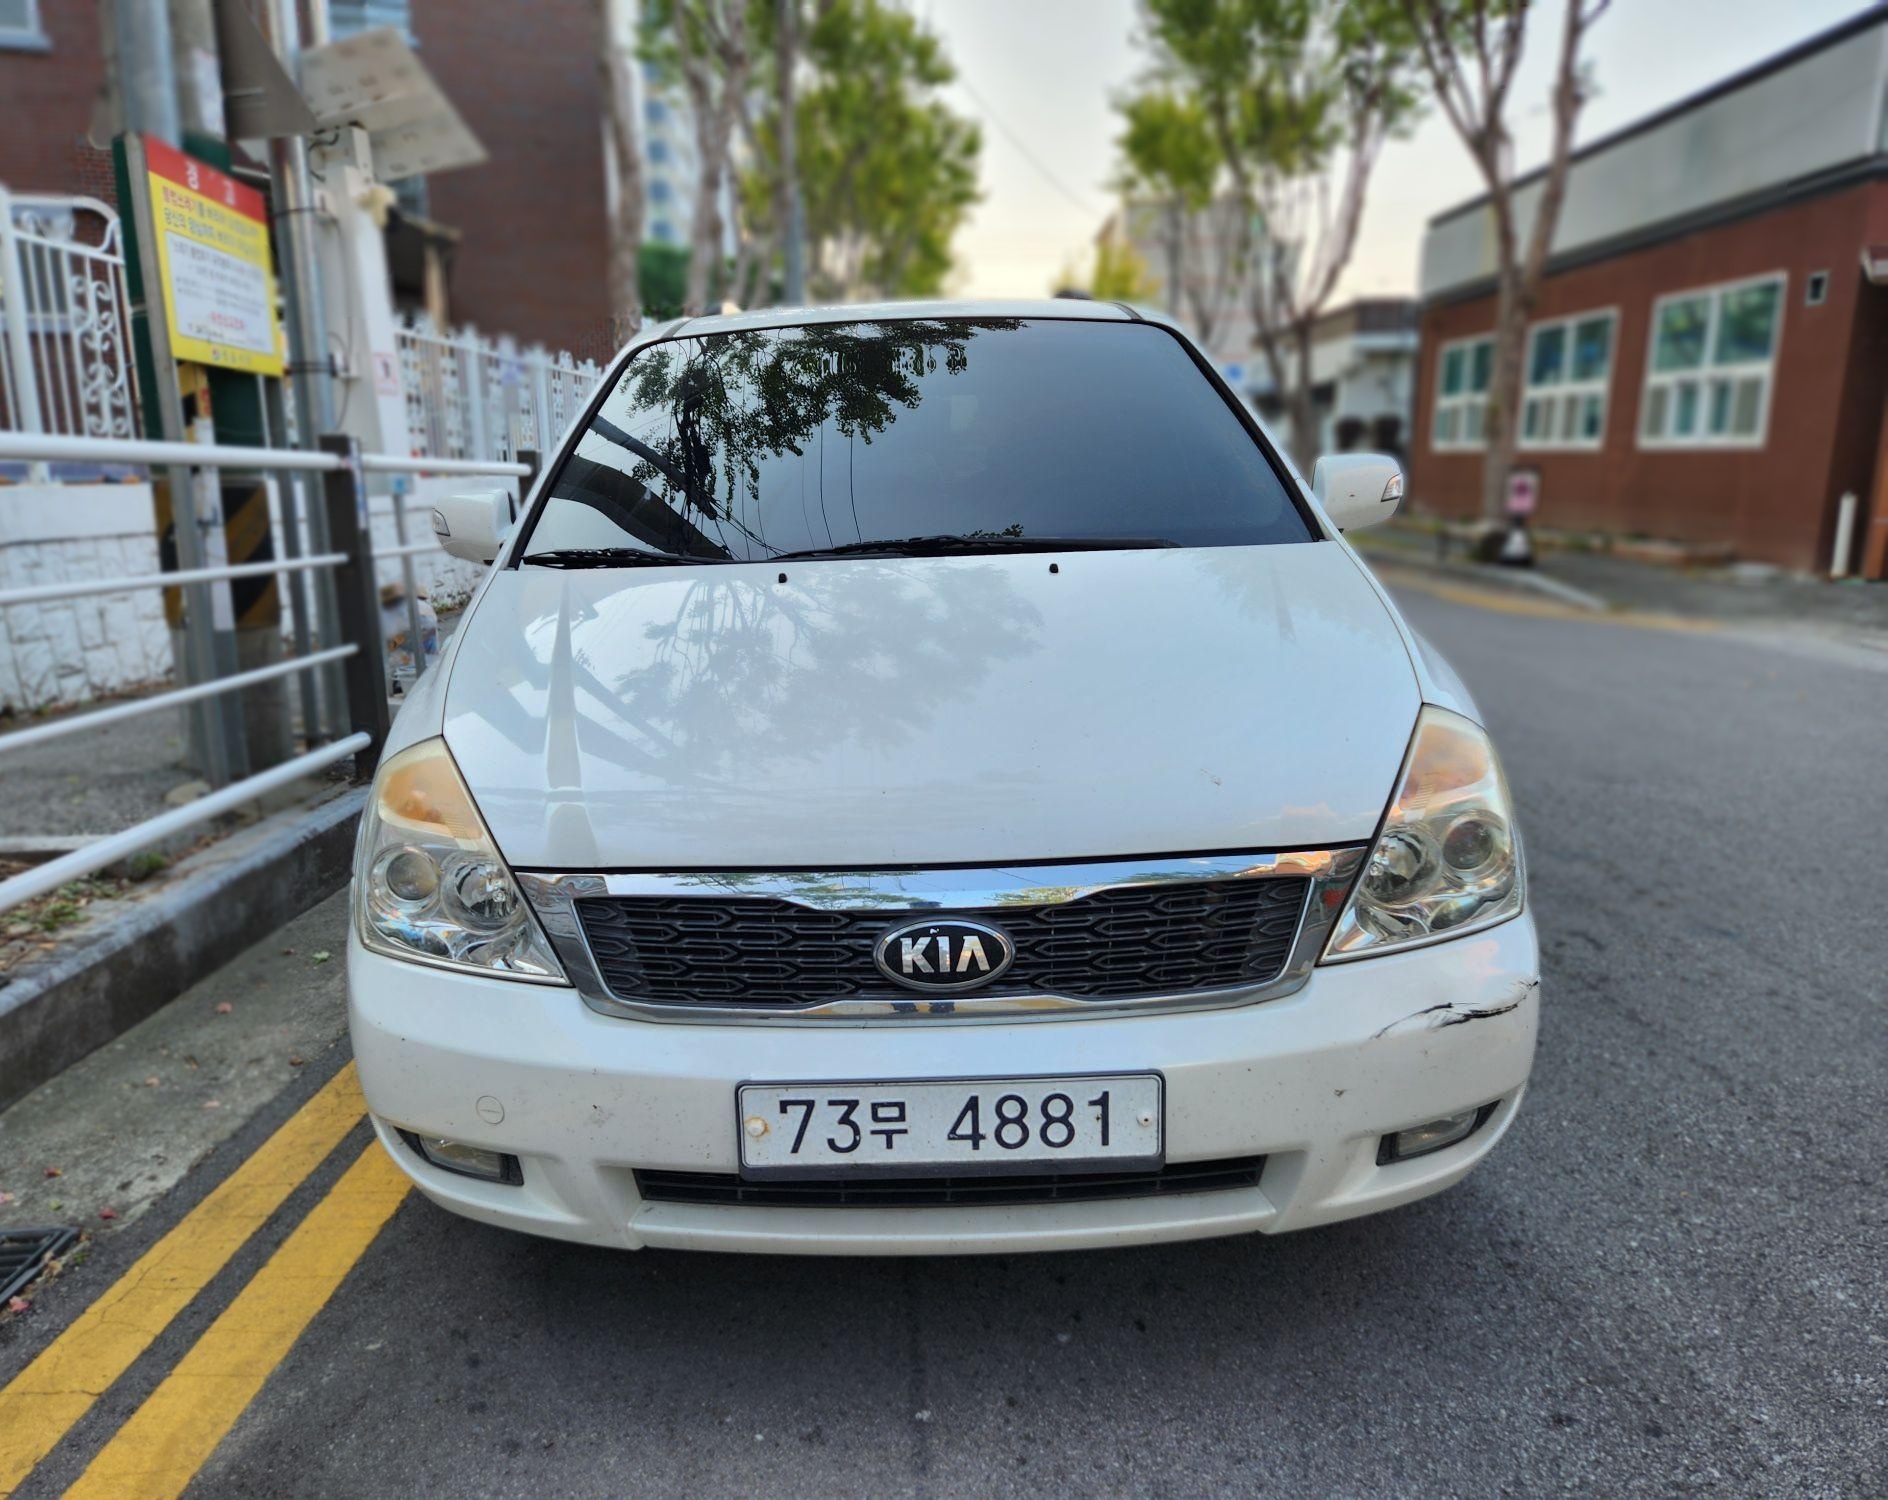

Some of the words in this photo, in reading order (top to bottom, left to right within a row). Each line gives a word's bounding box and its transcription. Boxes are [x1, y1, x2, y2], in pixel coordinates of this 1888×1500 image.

[900, 935, 990, 974] KIA
[779, 1098, 908, 1154] 73무
[947, 1090, 1110, 1151] 4881
